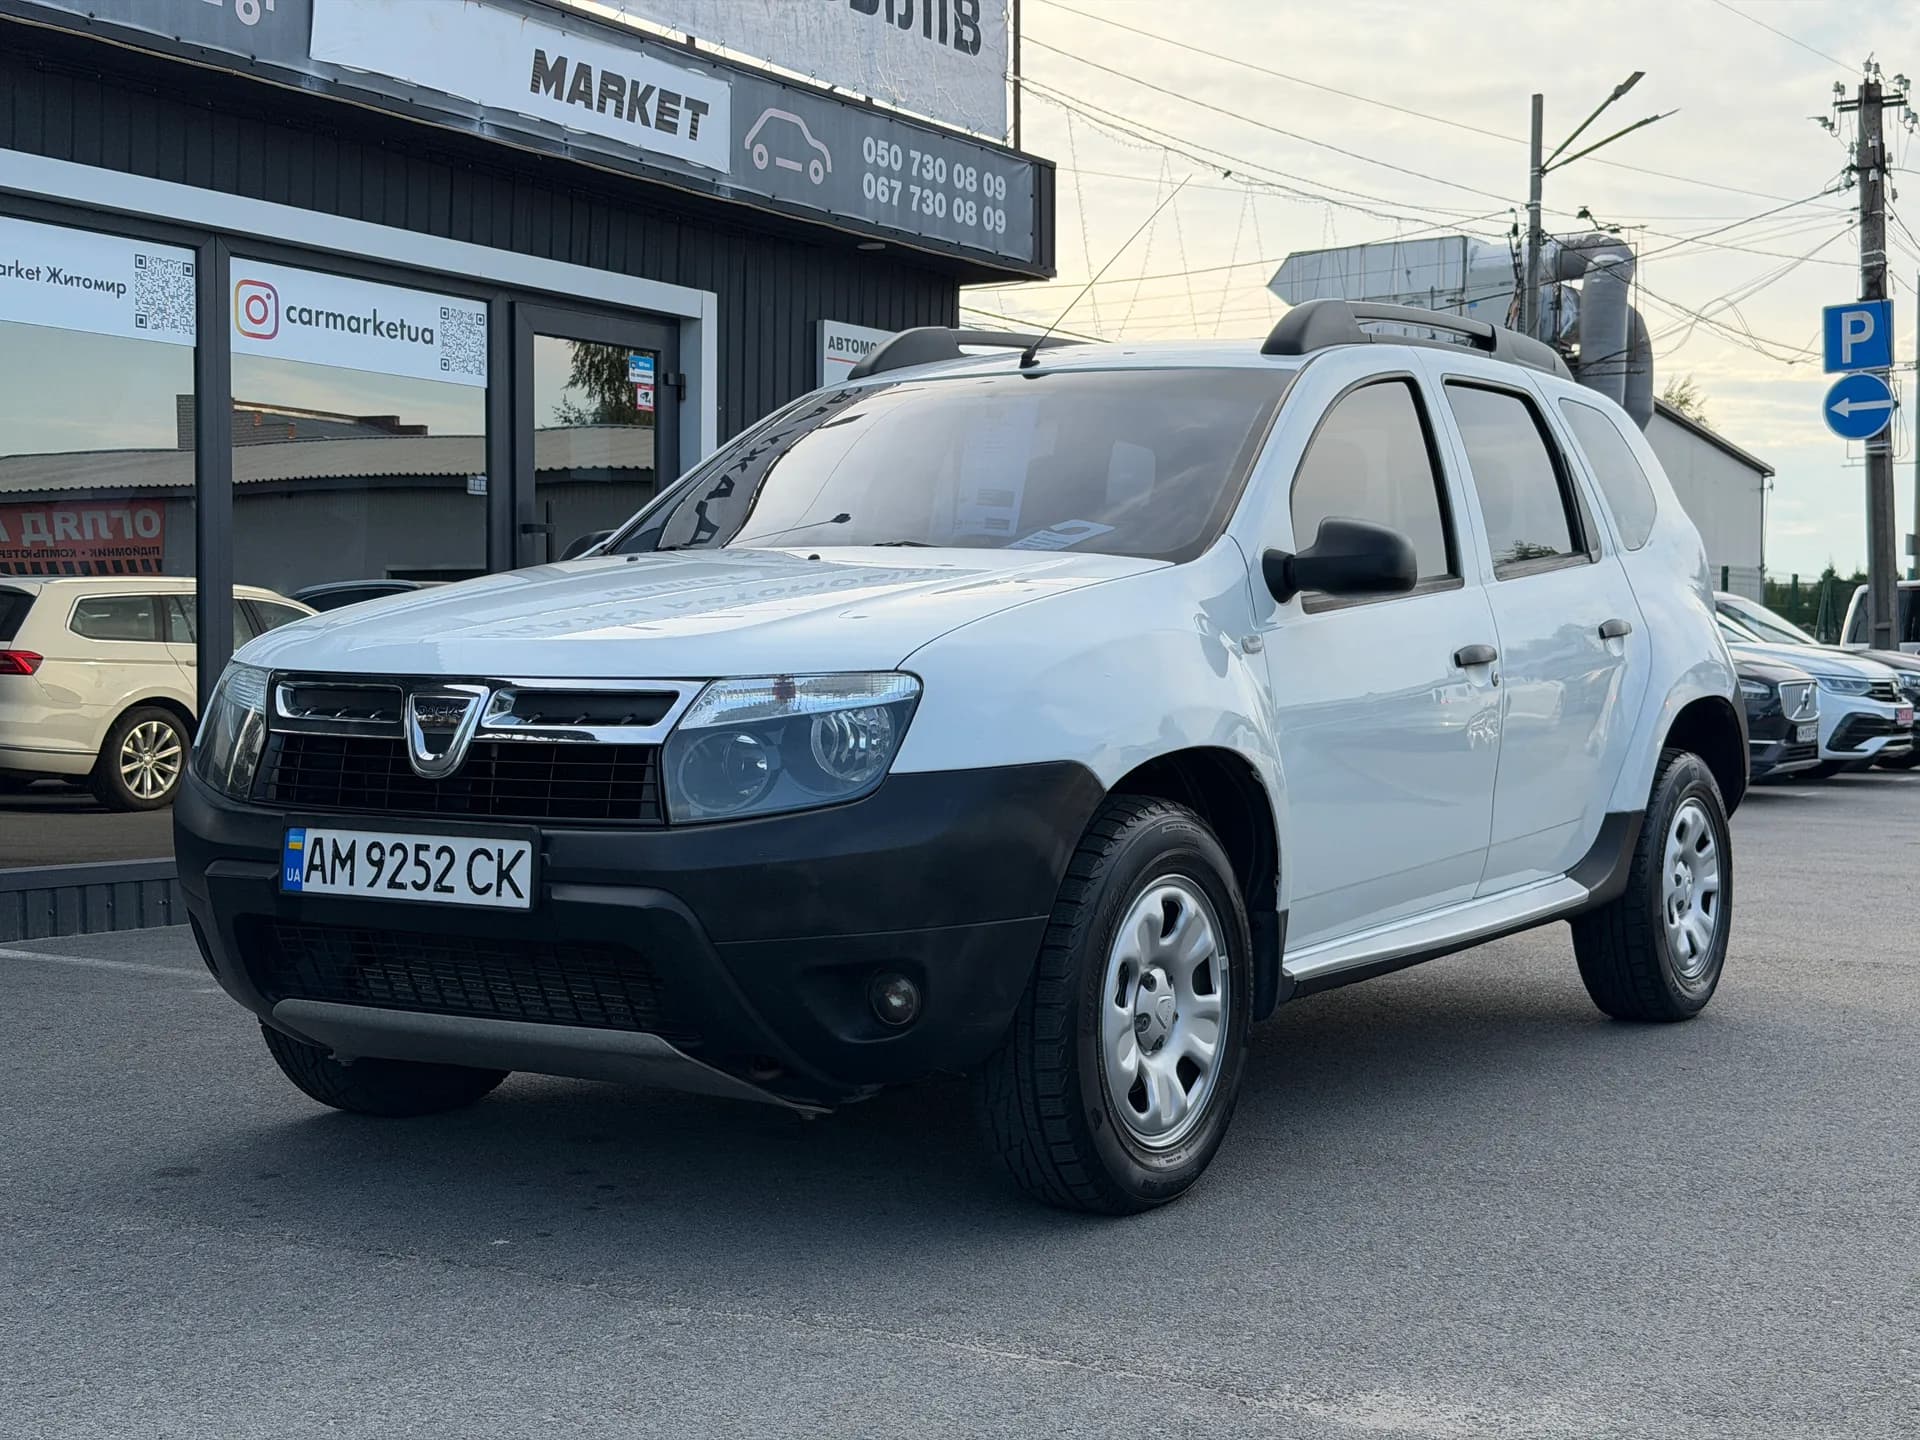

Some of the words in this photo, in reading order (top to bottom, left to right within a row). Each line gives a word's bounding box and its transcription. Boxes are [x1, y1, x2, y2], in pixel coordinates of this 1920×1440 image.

[530, 48, 710, 142] MARKET
[863, 136, 902, 171] 050
[910, 150, 947, 184] 730
[953, 163, 977, 193] 08
[983, 172, 1006, 201] 09
[863, 172, 902, 206] 067
[910, 185, 947, 218] 730
[953, 198, 977, 227] 08
[983, 206, 1006, 235] 09
[46, 266, 127, 299] Житомир
[286, 304, 434, 345] carmarketua
[1841, 310, 1874, 364] P
[286, 867, 301, 882] UA
[304, 837, 356, 886] AM
[366, 841, 456, 893] 9252
[466, 847, 526, 899] CK
